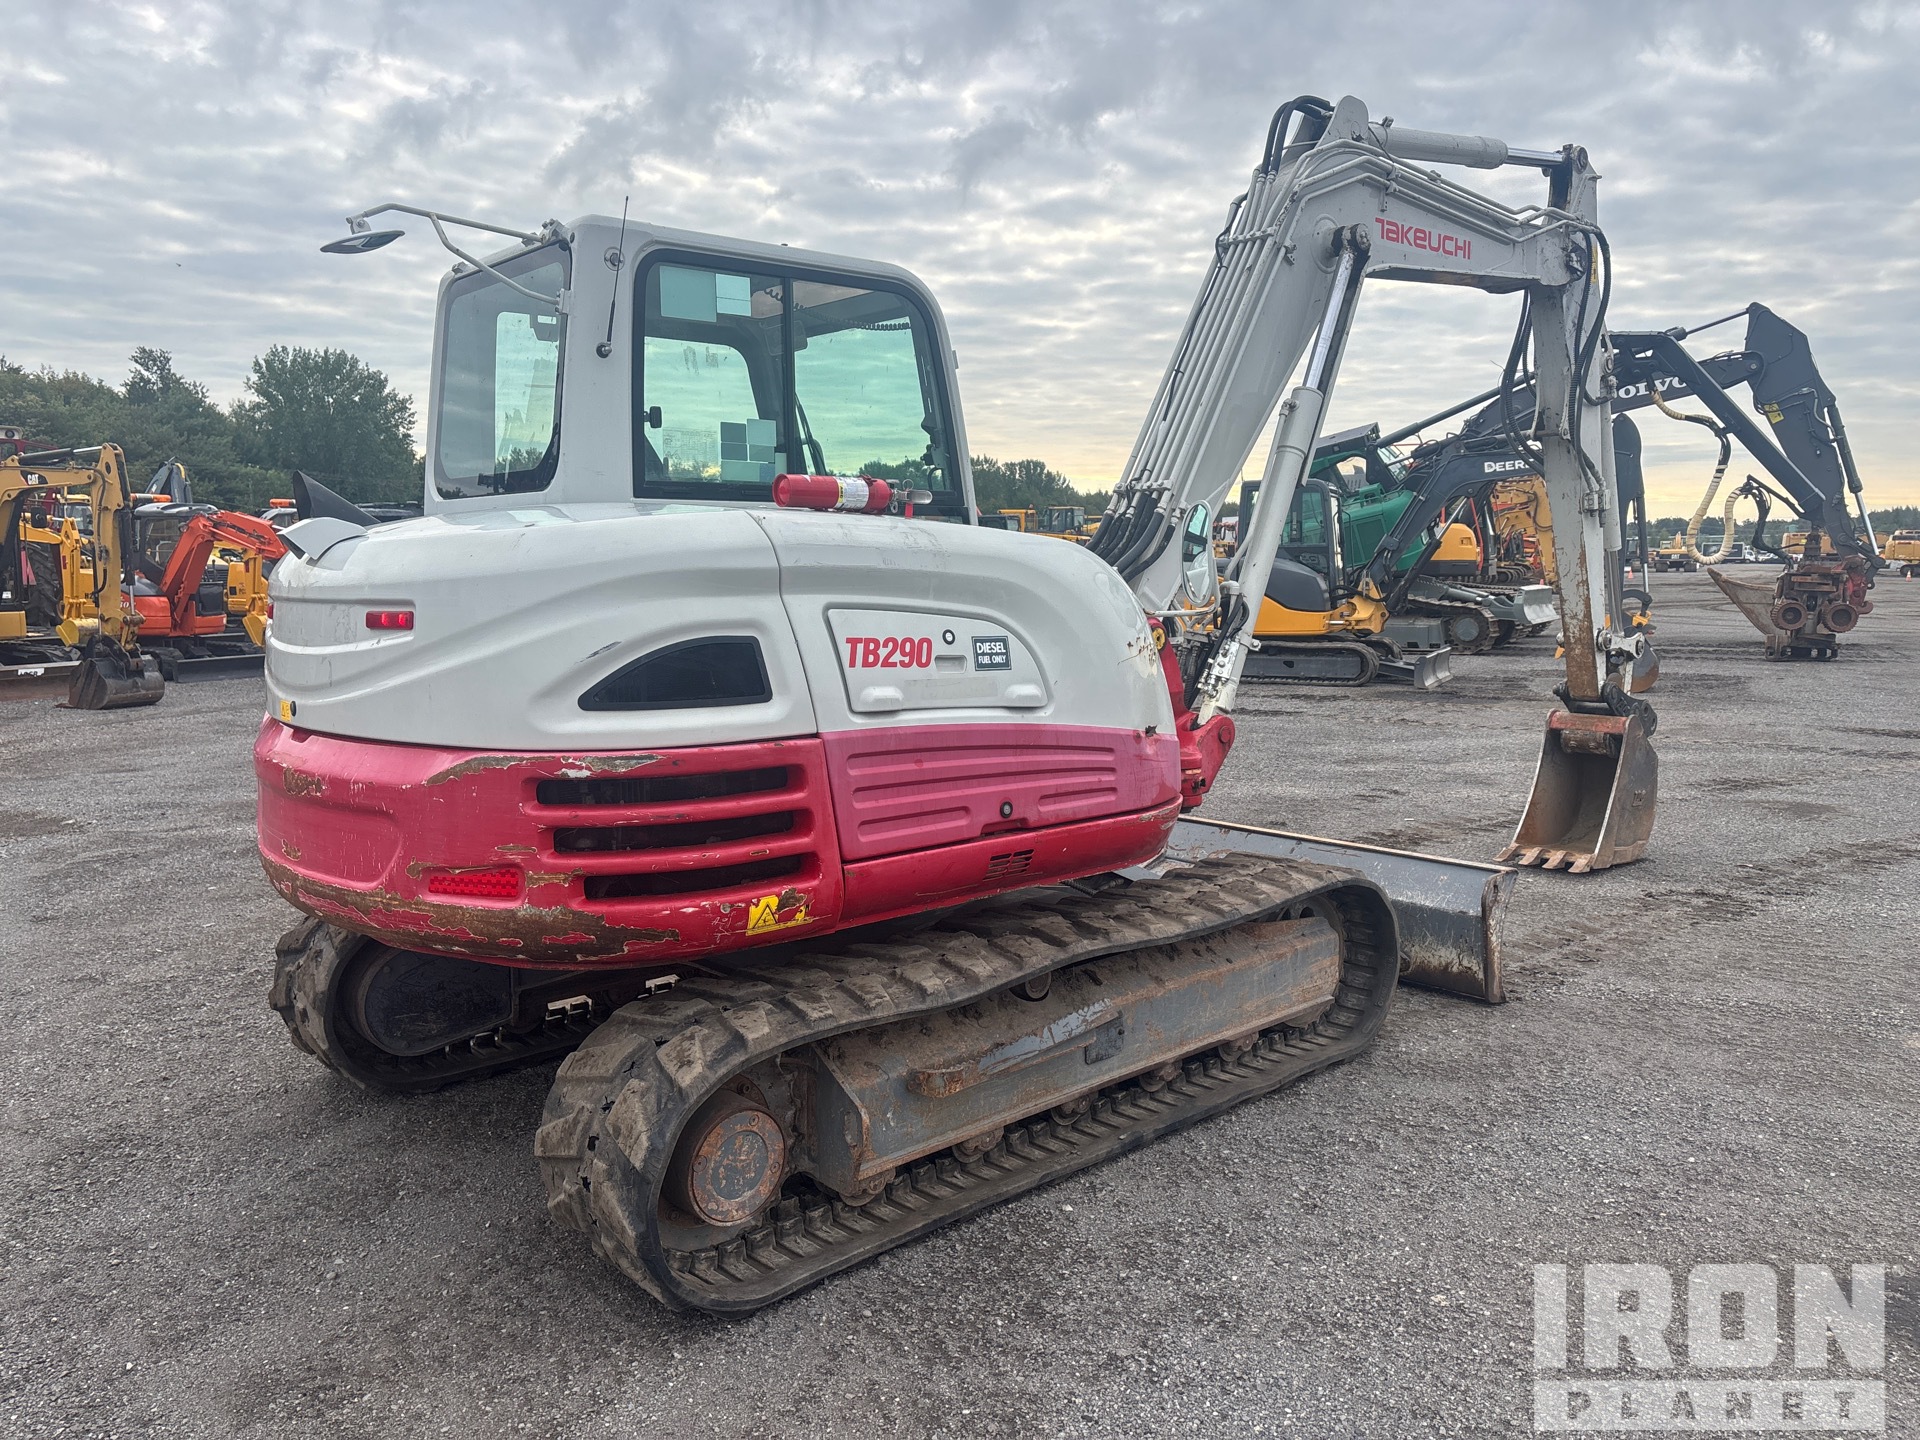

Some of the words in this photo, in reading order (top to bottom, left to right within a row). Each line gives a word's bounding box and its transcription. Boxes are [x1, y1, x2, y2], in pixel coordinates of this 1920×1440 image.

[1483, 460, 1530, 473] DEER
[27, 474, 39, 485] CAT
[845, 636, 933, 669] TB290
[976, 642, 1006, 653] DIESEL
[978, 655, 991, 664] FUEL
[991, 655, 1006, 664] ONLY
